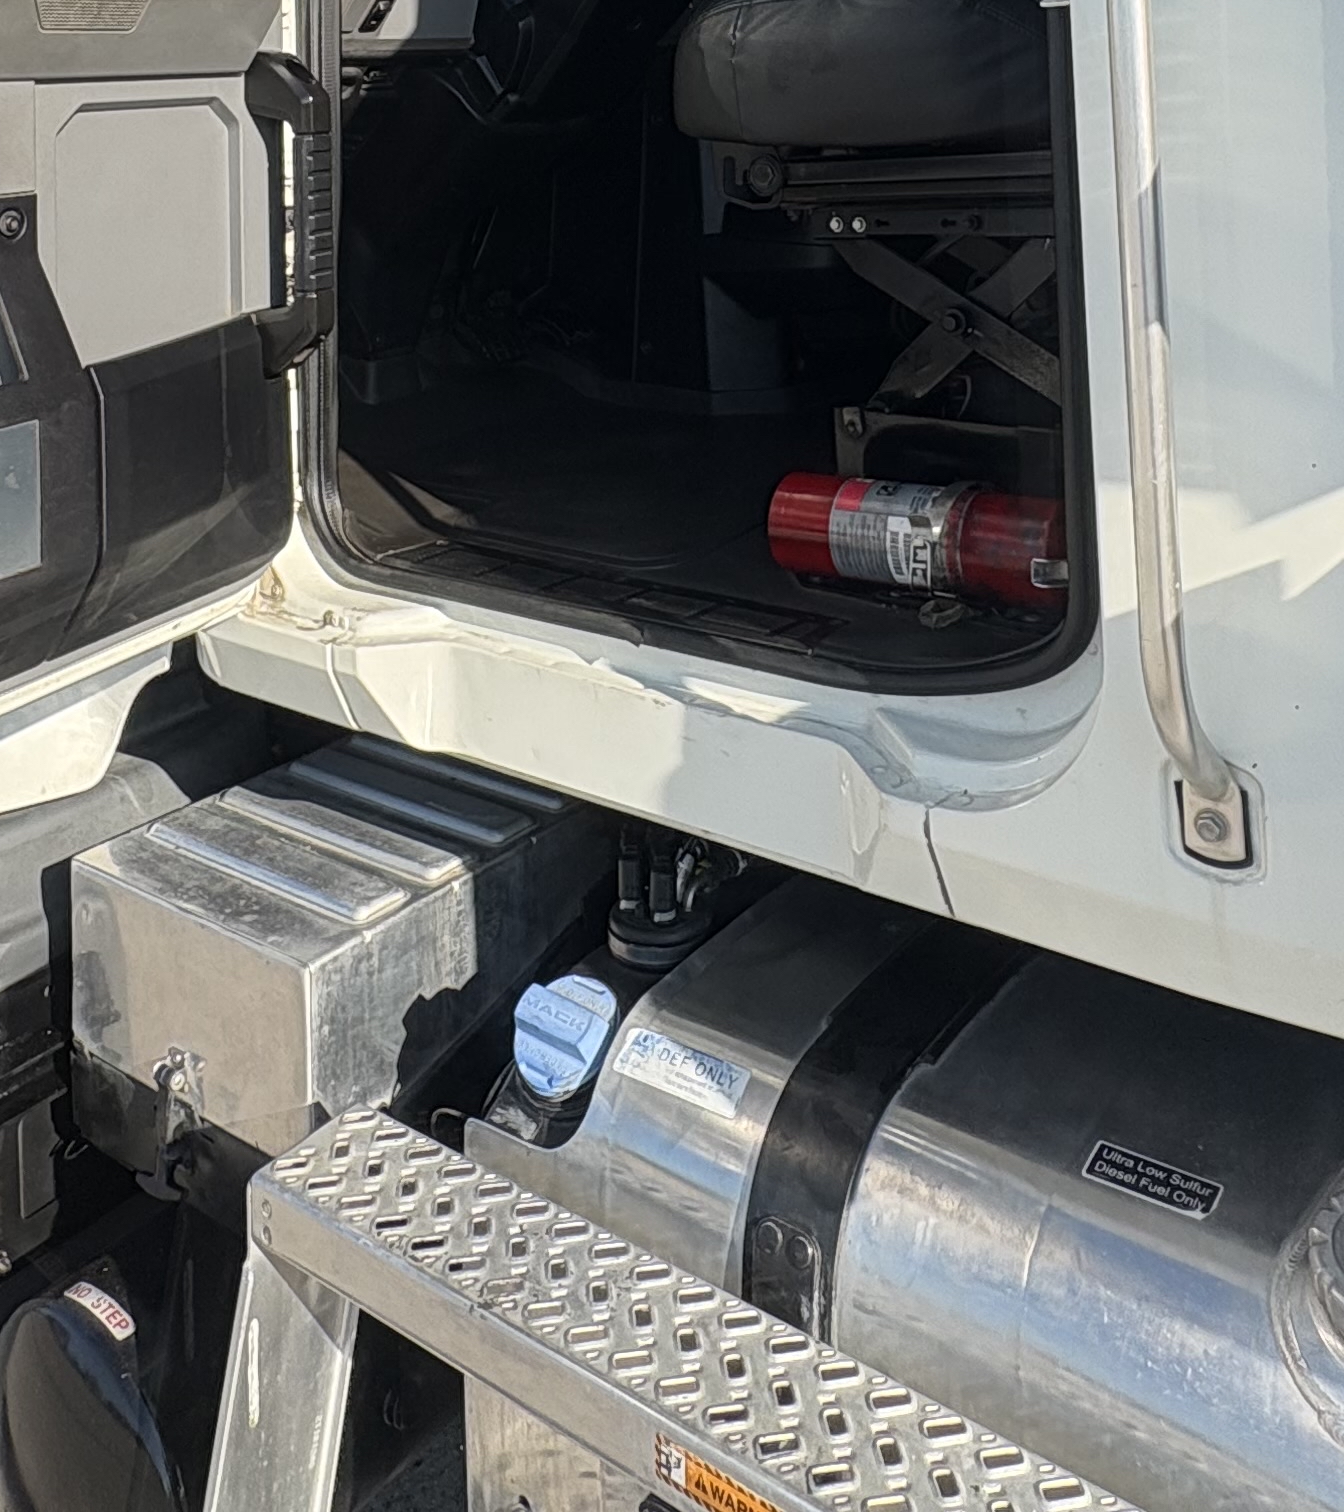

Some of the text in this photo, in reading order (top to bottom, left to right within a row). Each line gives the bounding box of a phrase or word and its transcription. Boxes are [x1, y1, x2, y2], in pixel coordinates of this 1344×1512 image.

[522, 995, 585, 1031] MACK
[659, 1048, 692, 1068] DEF
[695, 1062, 739, 1089] ONLY
[1094, 1160, 1206, 1212] Diesel Fuel Only
[1102, 1148, 1214, 1196] Ultra Low Sulfur
[68, 1284, 130, 1330] NO STEP
